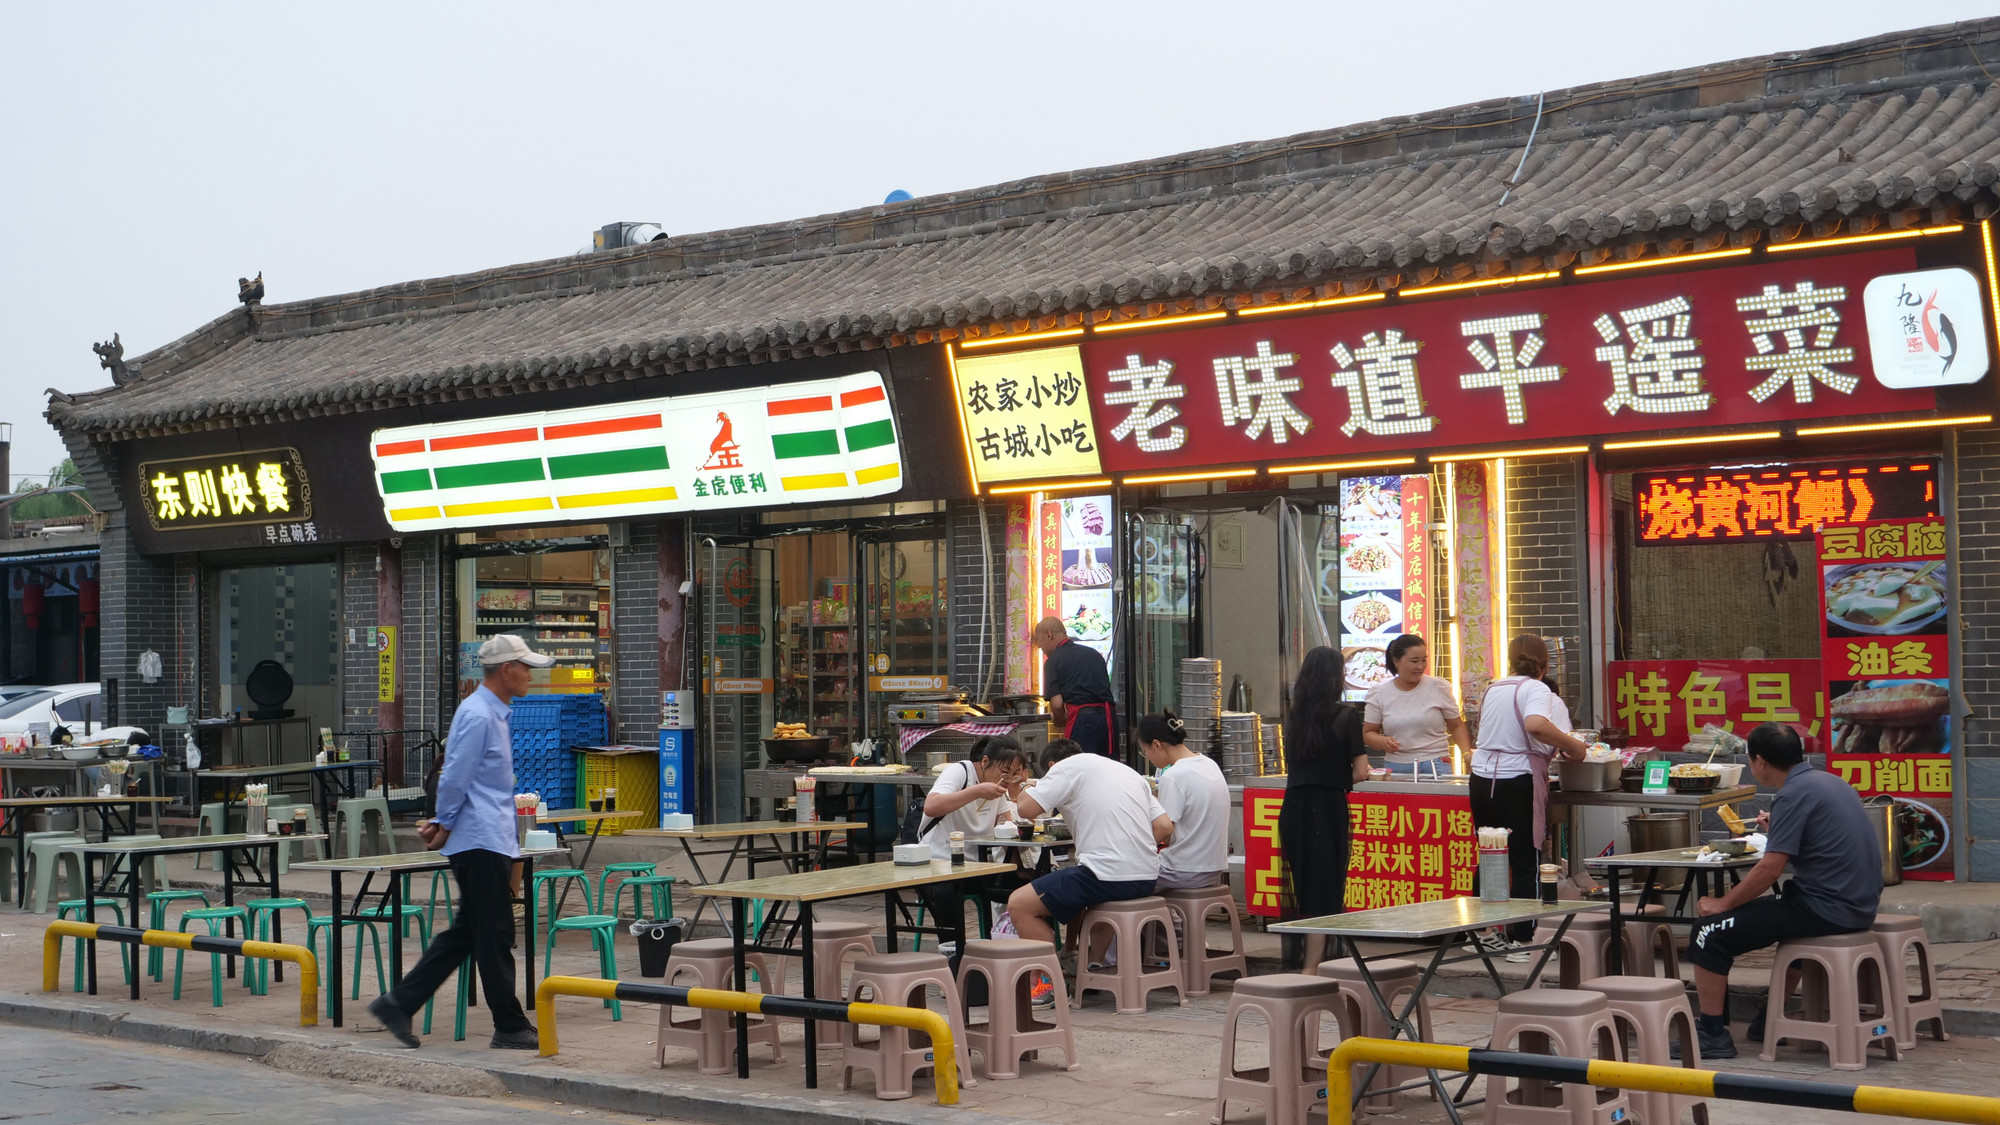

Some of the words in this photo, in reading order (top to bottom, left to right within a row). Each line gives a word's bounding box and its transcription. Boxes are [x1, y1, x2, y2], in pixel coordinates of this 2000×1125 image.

[1103, 281, 1860, 453] 老味道平遥菜
[967, 371, 1082, 415] 农家小炒
[975, 418, 1094, 461] 古城小吃
[151, 462, 291, 521] 东则快餐
[692, 471, 768, 497] 金虎便利
[265, 521, 318, 545] 早点碗秃
[1820, 521, 1946, 560] 豆腐脑
[1044, 512, 1058, 611] 真材实料用
[381, 654, 391, 698] 禁止停车
[877, 656, 889, 671] 拉
[1846, 640, 1933, 676] 油条
[1616, 671, 1824, 737] 特色早
[1831, 758, 1952, 793] 刀削面
[1365, 804, 1390, 910] 黑米粥
[1390, 805, 1415, 904] 小米粥
[1418, 808, 1445, 903] 刀削面
[1447, 810, 1474, 897] 烙饼油
